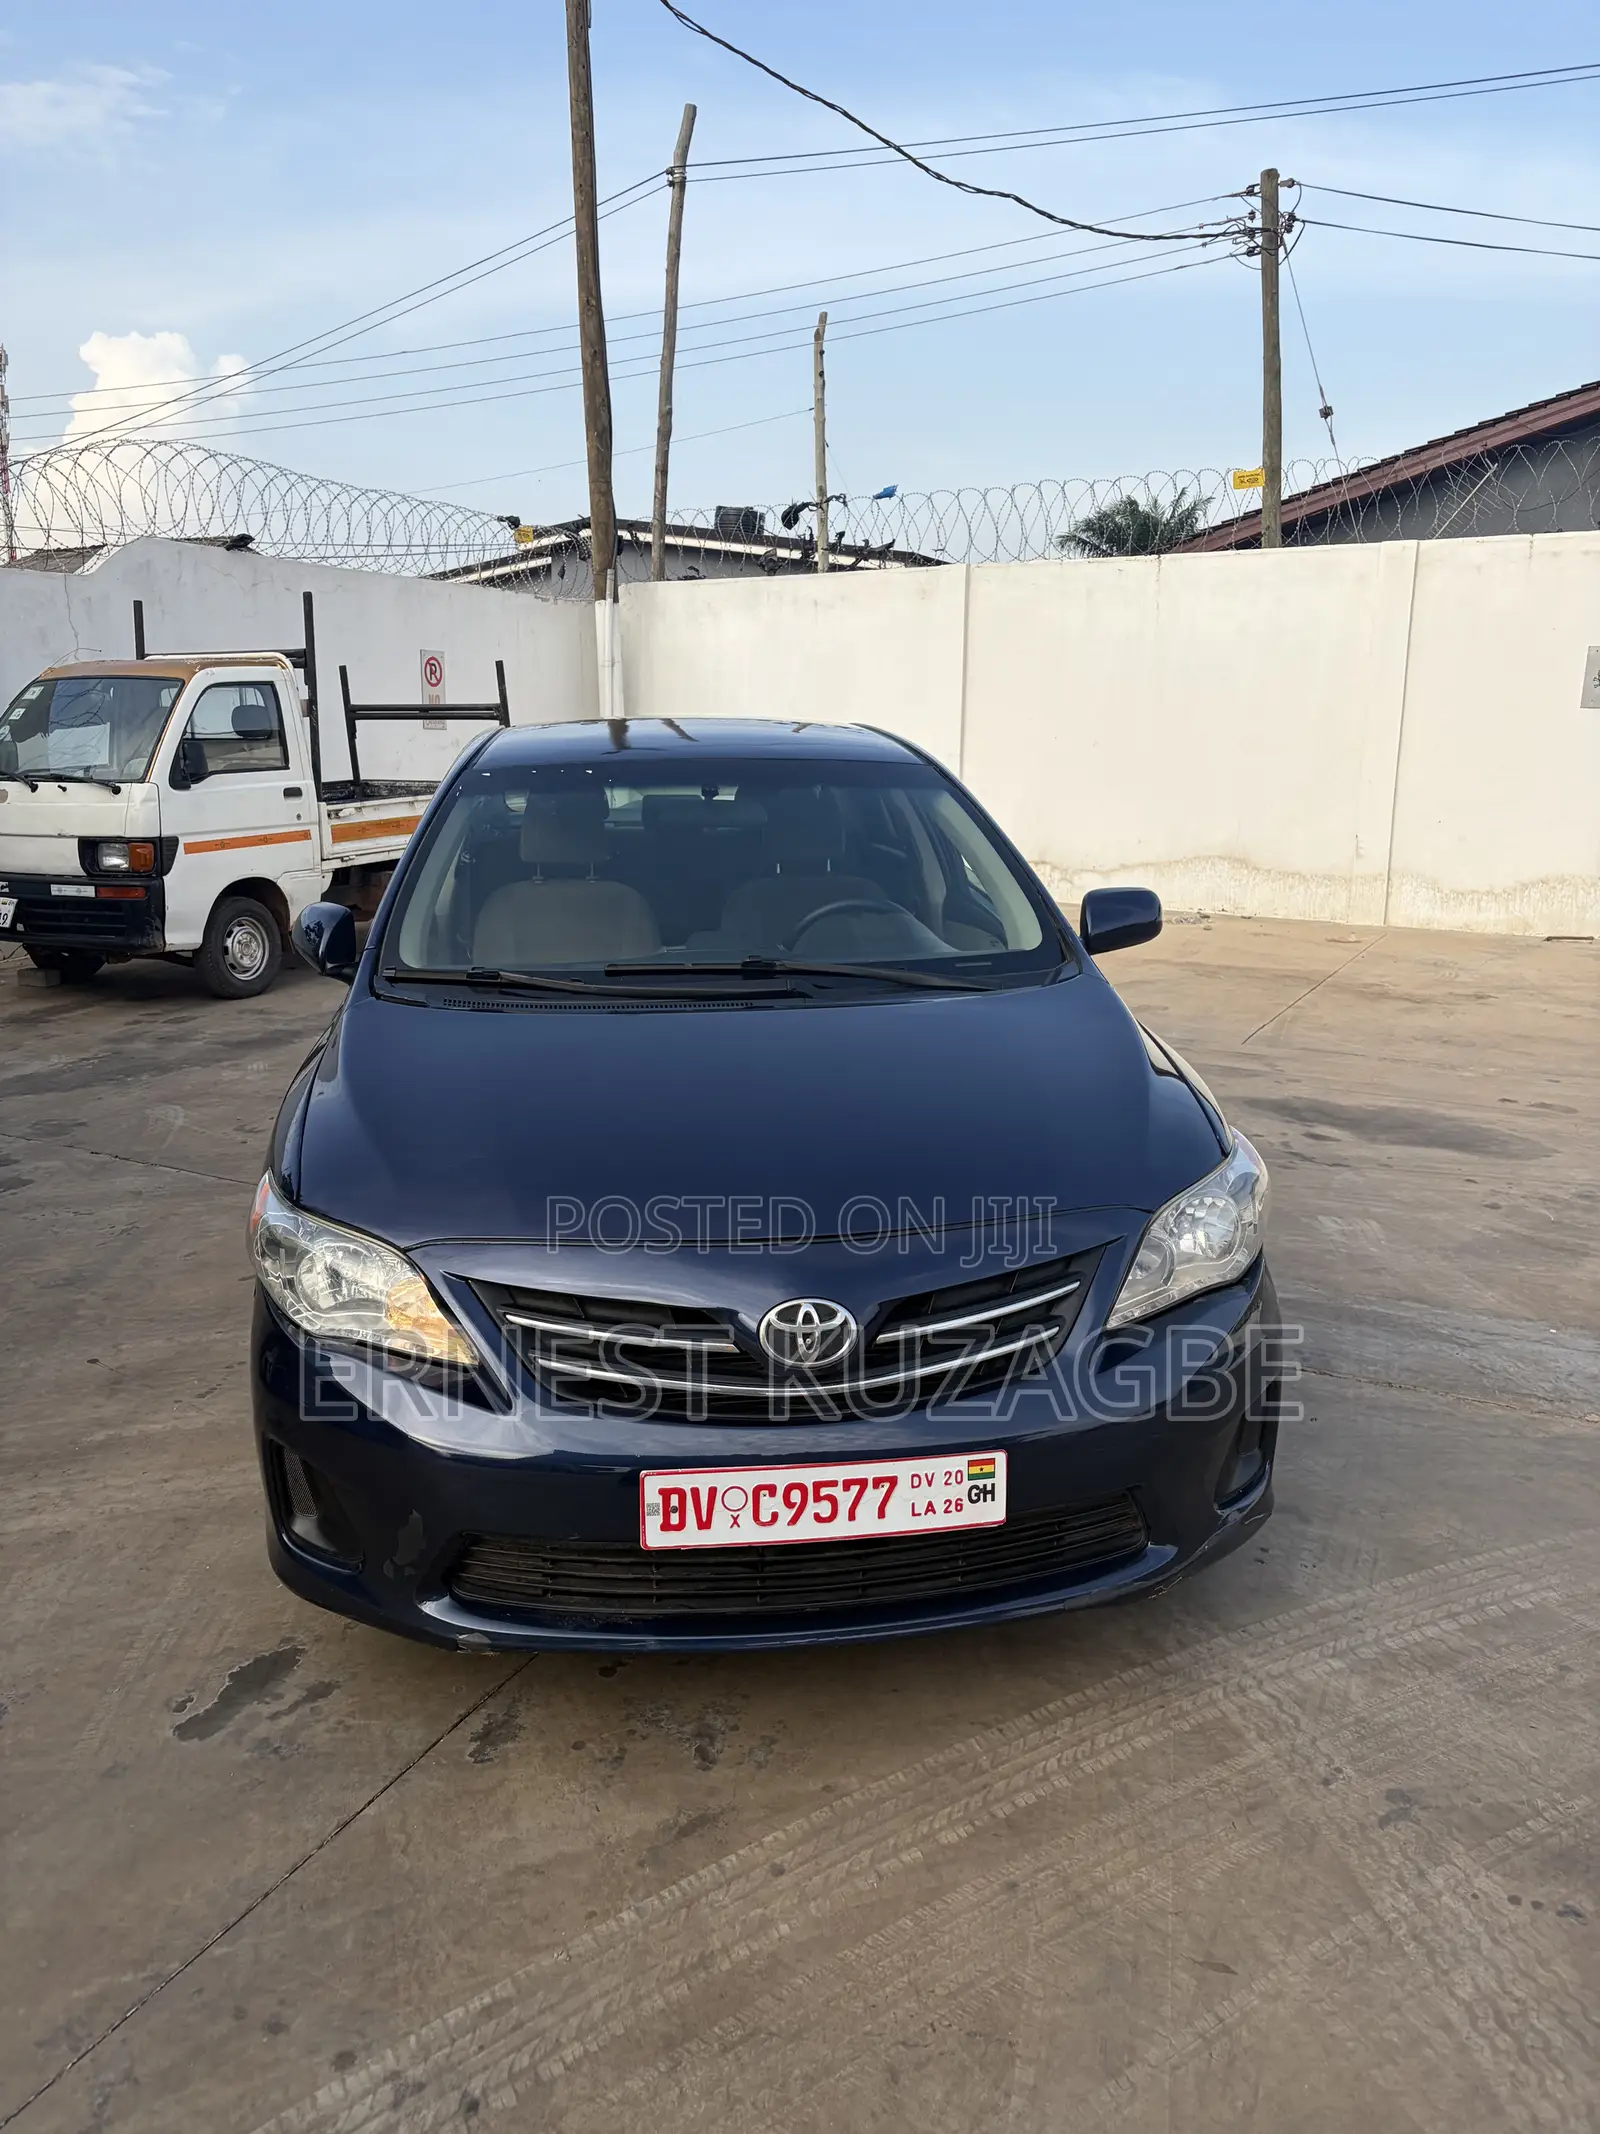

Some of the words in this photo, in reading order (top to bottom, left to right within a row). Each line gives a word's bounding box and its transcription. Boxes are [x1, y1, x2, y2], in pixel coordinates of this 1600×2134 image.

[910, 1472, 935, 1489] DV
[943, 1468, 964, 1485] 20
[657, 1485, 718, 1532] DV
[751, 1475, 898, 1527] C9577
[966, 1482, 996, 1505] GH
[910, 1500, 937, 1517] LA
[943, 1497, 964, 1514] 26
